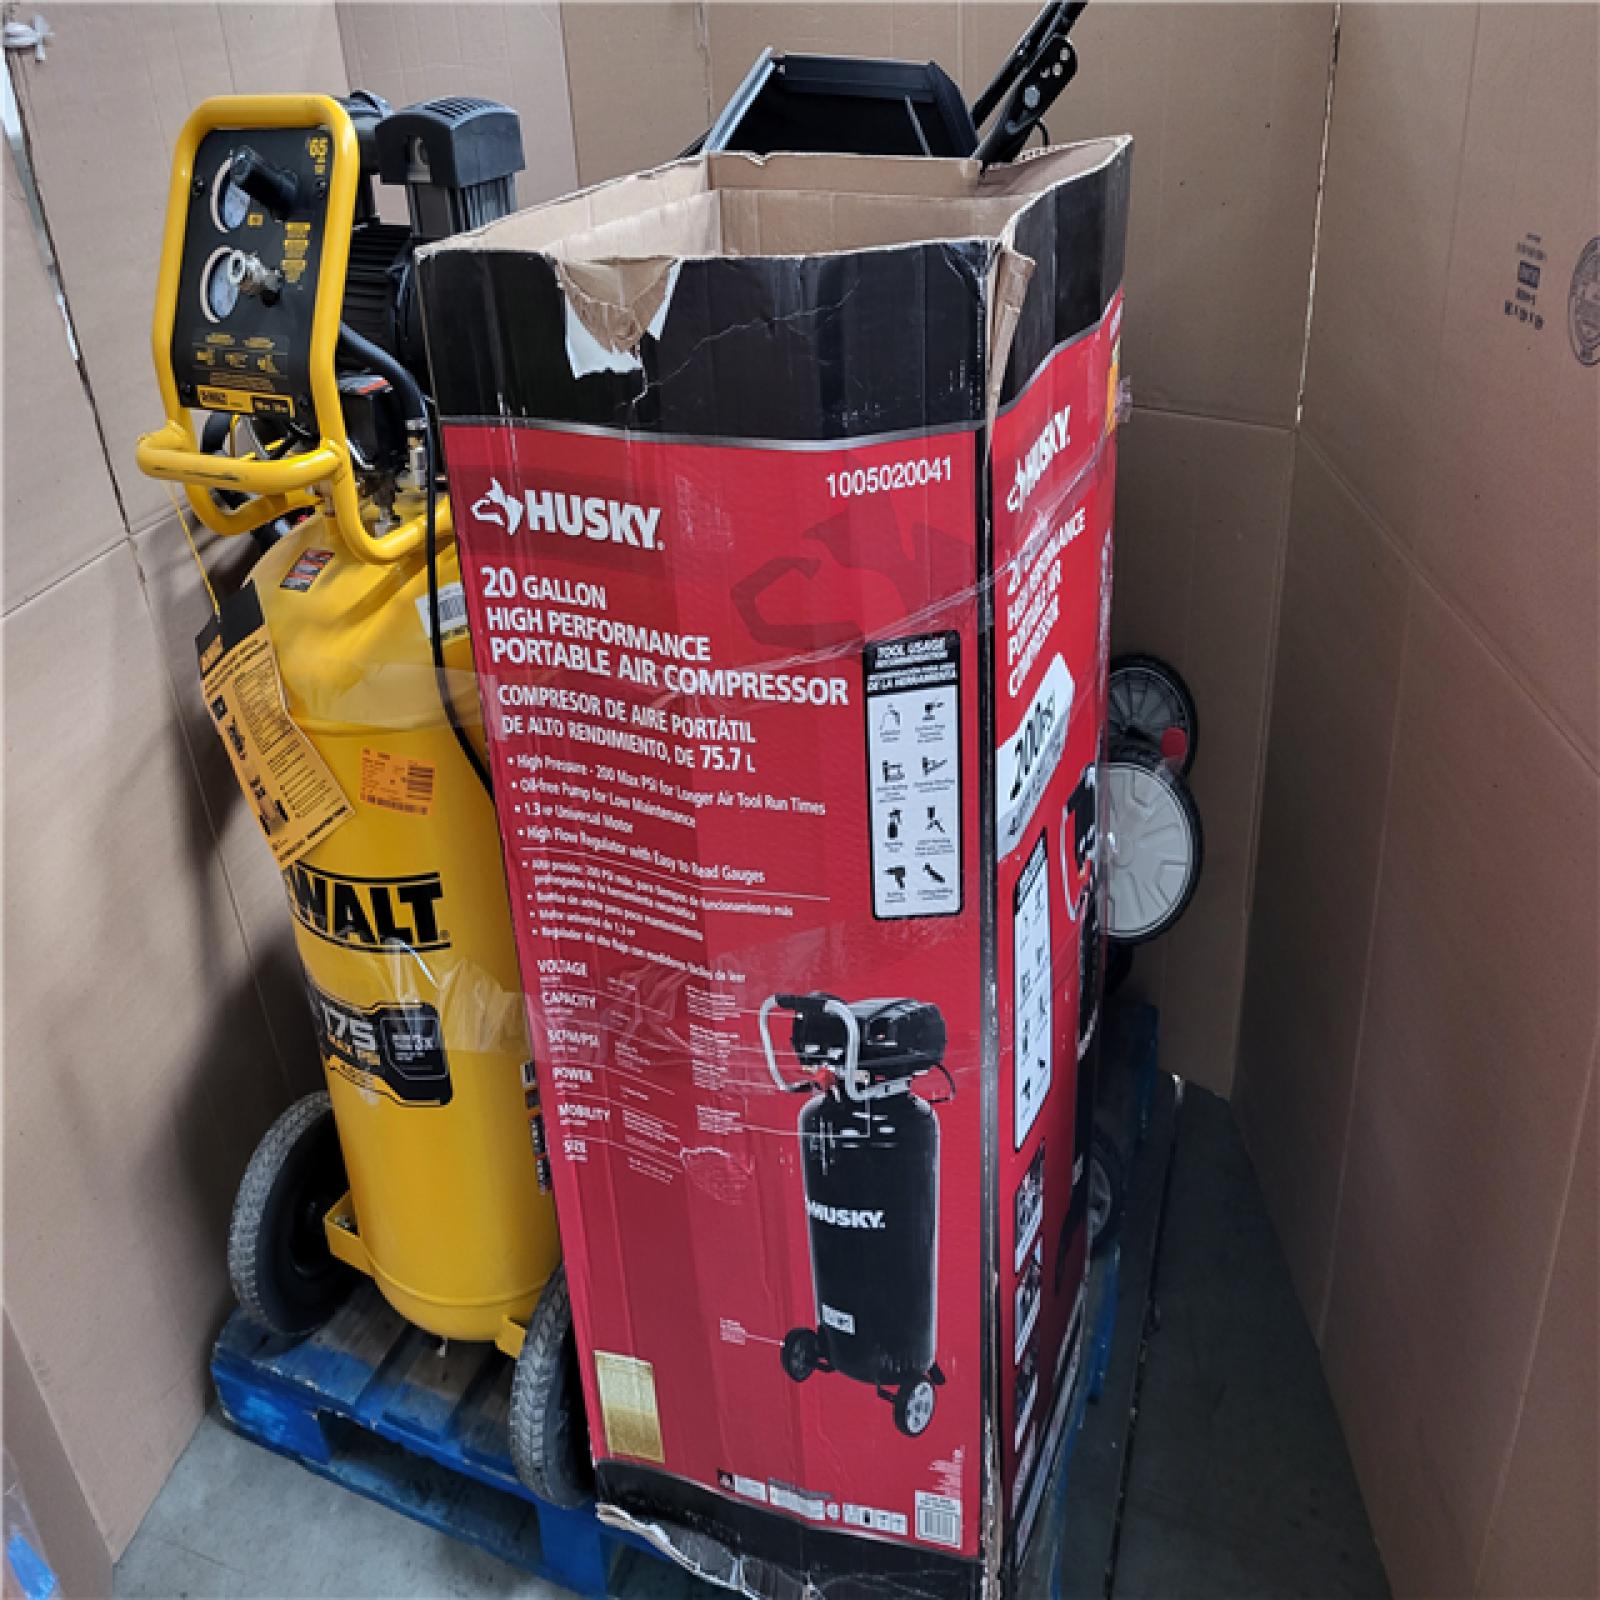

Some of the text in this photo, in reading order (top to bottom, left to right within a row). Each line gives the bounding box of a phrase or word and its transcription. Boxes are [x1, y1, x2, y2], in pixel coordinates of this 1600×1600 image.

[826, 455, 951, 498] 1005020041
[524, 489, 661, 549] HUSKY
[480, 566, 608, 610] 20 GALLON
[486, 606, 543, 632] HIGH
[547, 609, 711, 661] PERFORMANCE
[490, 637, 611, 676] PORTABLE
[617, 654, 658, 687] AIR
[664, 664, 849, 705] COMPRESSOR
[499, 684, 757, 743] COMPRESOR DE AIRE PORTÁTIL
[502, 715, 755, 773] DE ALTO RENDIMIENTO, DE 75.7 L
[517, 754, 542, 773] High
[617, 769, 639, 787] Max
[641, 774, 658, 792] PSI
[659, 779, 673, 796] for
[676, 784, 713, 808] Longer
[717, 789, 733, 806] Air
[737, 792, 763, 808] Tool
[764, 794, 788, 811] Run
[790, 796, 826, 816] Times
[561, 782, 590, 803] Pump
[592, 787, 606, 804] for
[609, 791, 631, 810] Low
[632, 797, 695, 828] Maintenance
[524, 801, 541, 816] 1.3
[554, 804, 601, 826] Universal
[602, 813, 633, 834] Motor
[527, 825, 551, 843] High
[554, 826, 579, 844] Flow
[579, 830, 626, 856] Regulator
[629, 844, 651, 861] with
[654, 849, 676, 873] Easy
[692, 862, 718, 879] Read
[722, 864, 766, 886] Gauges
[537, 959, 588, 977] VOLTAGE
[807, 1200, 885, 1229] HUSKY
